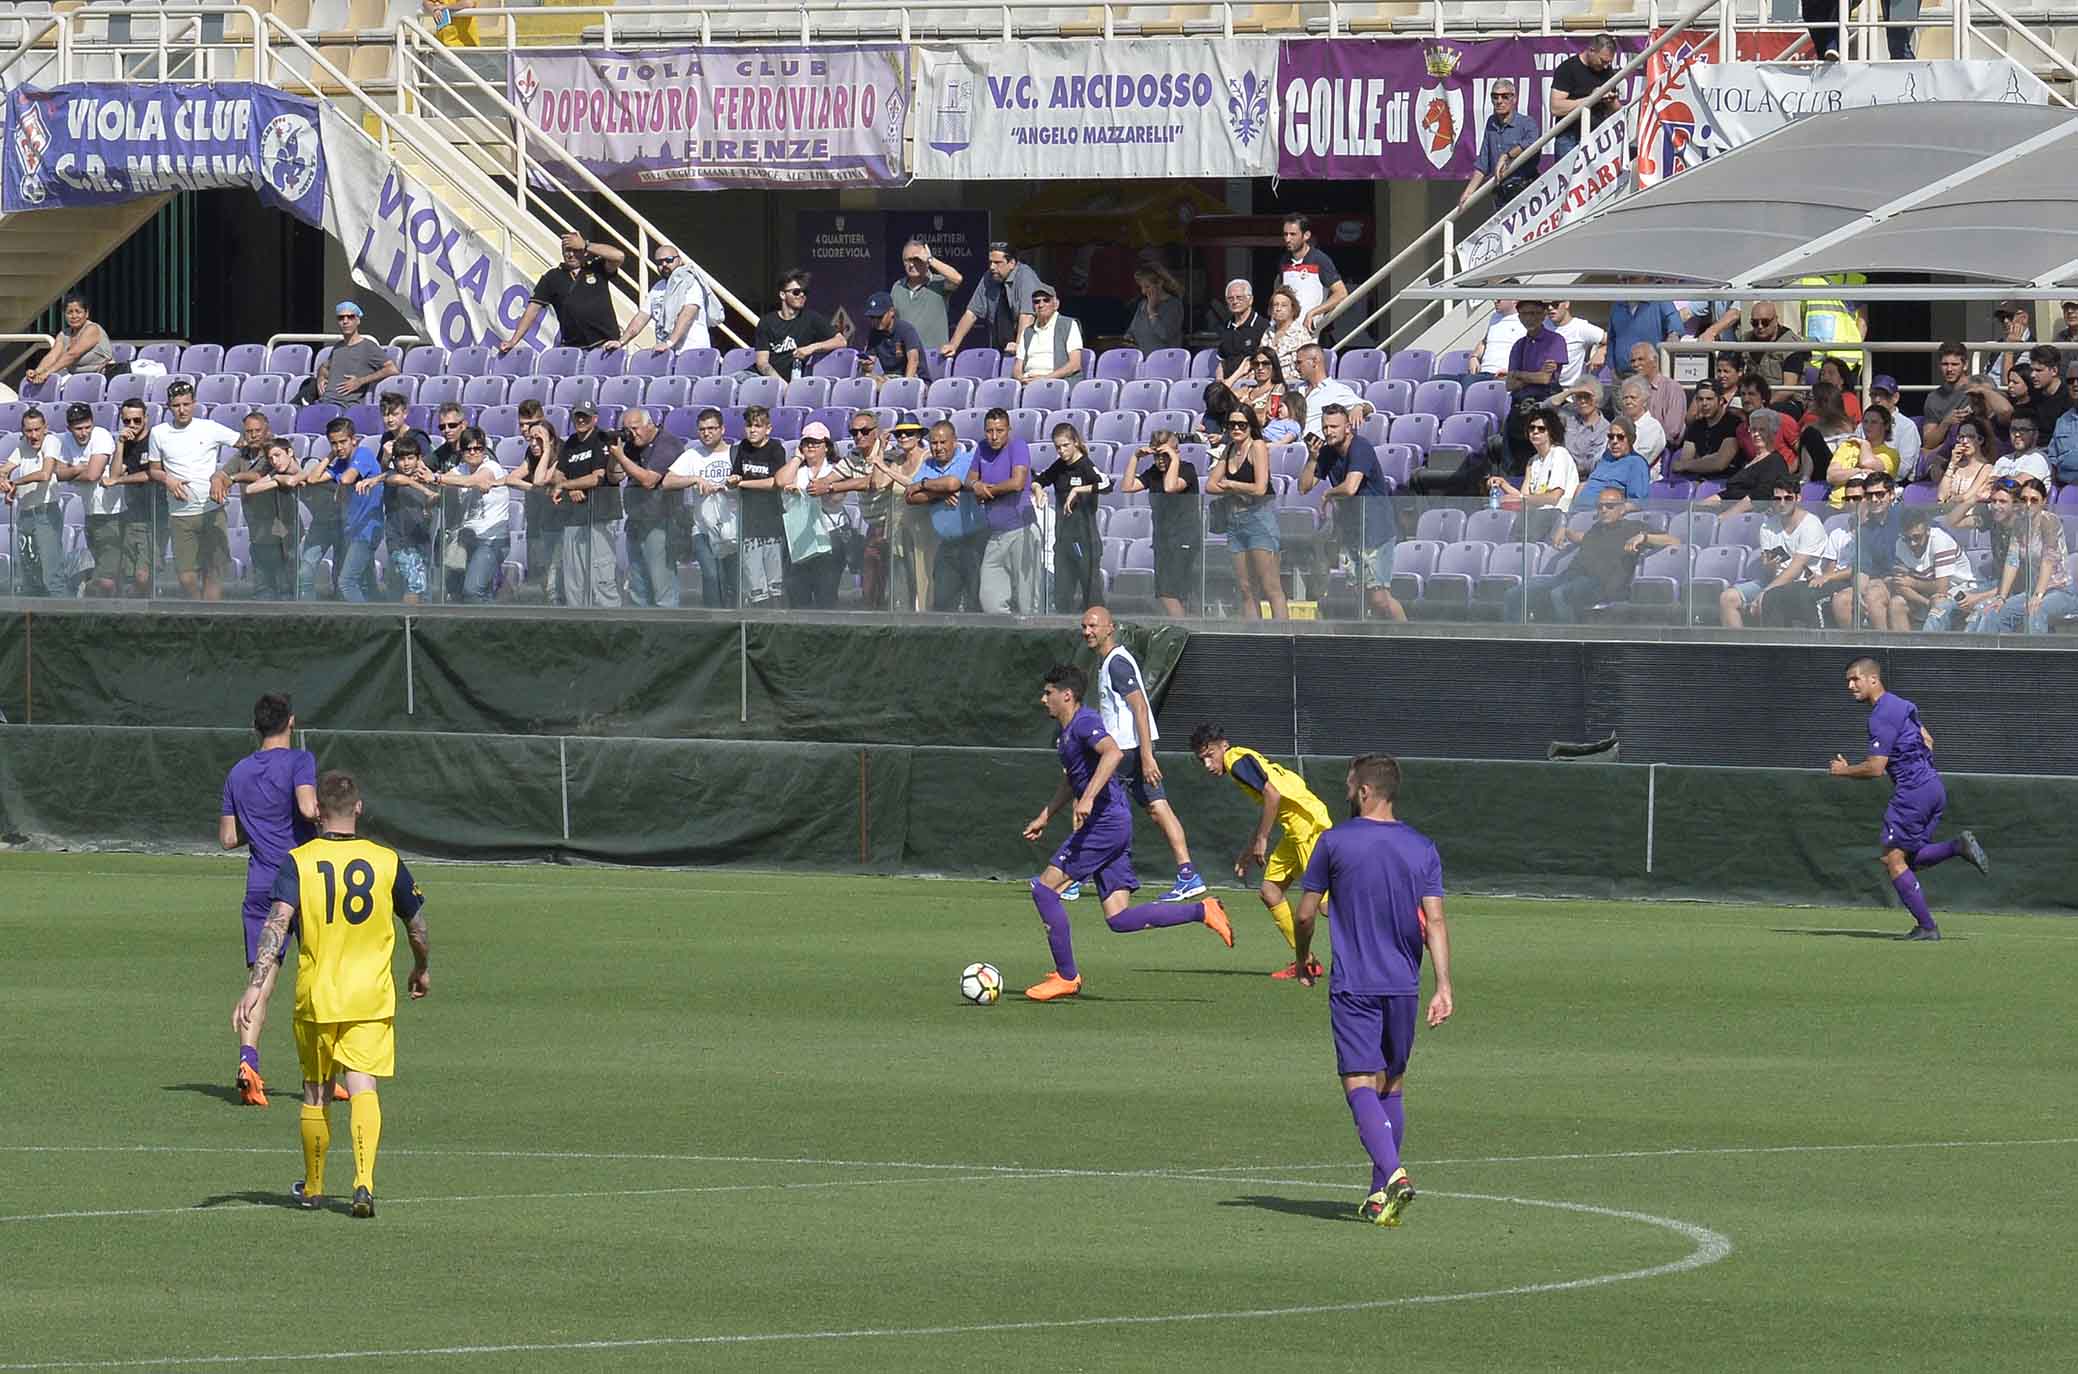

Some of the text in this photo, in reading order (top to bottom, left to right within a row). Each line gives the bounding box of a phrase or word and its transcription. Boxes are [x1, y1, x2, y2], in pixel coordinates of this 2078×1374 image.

[600, 60, 827, 80] VIOLA CLUB
[540, 84, 876, 134] DOPOLAVORO FERROVIARIO
[987, 72, 1212, 109] V.C. ARCIDOSSO
[1701, 87, 1842, 114] VIOLA CLUB
[67, 98, 168, 141] VIOLA
[174, 99, 250, 141] CLUB
[1011, 124, 1184, 145] "ANGELO MAZZARELLI"
[1285, 77, 1383, 157] COLLE
[1386, 91, 1409, 143] di
[683, 139, 829, 161] FIRENZE
[56, 153, 122, 192] C.R.
[1502, 119, 1625, 236] VIOLA CLUB
[379, 174, 491, 304] VIOLA
[817, 247, 845, 258] CUORE
[846, 247, 871, 258] VIOLA
[944, 246, 973, 257] VIOLA
[317, 859, 374, 924] 18
